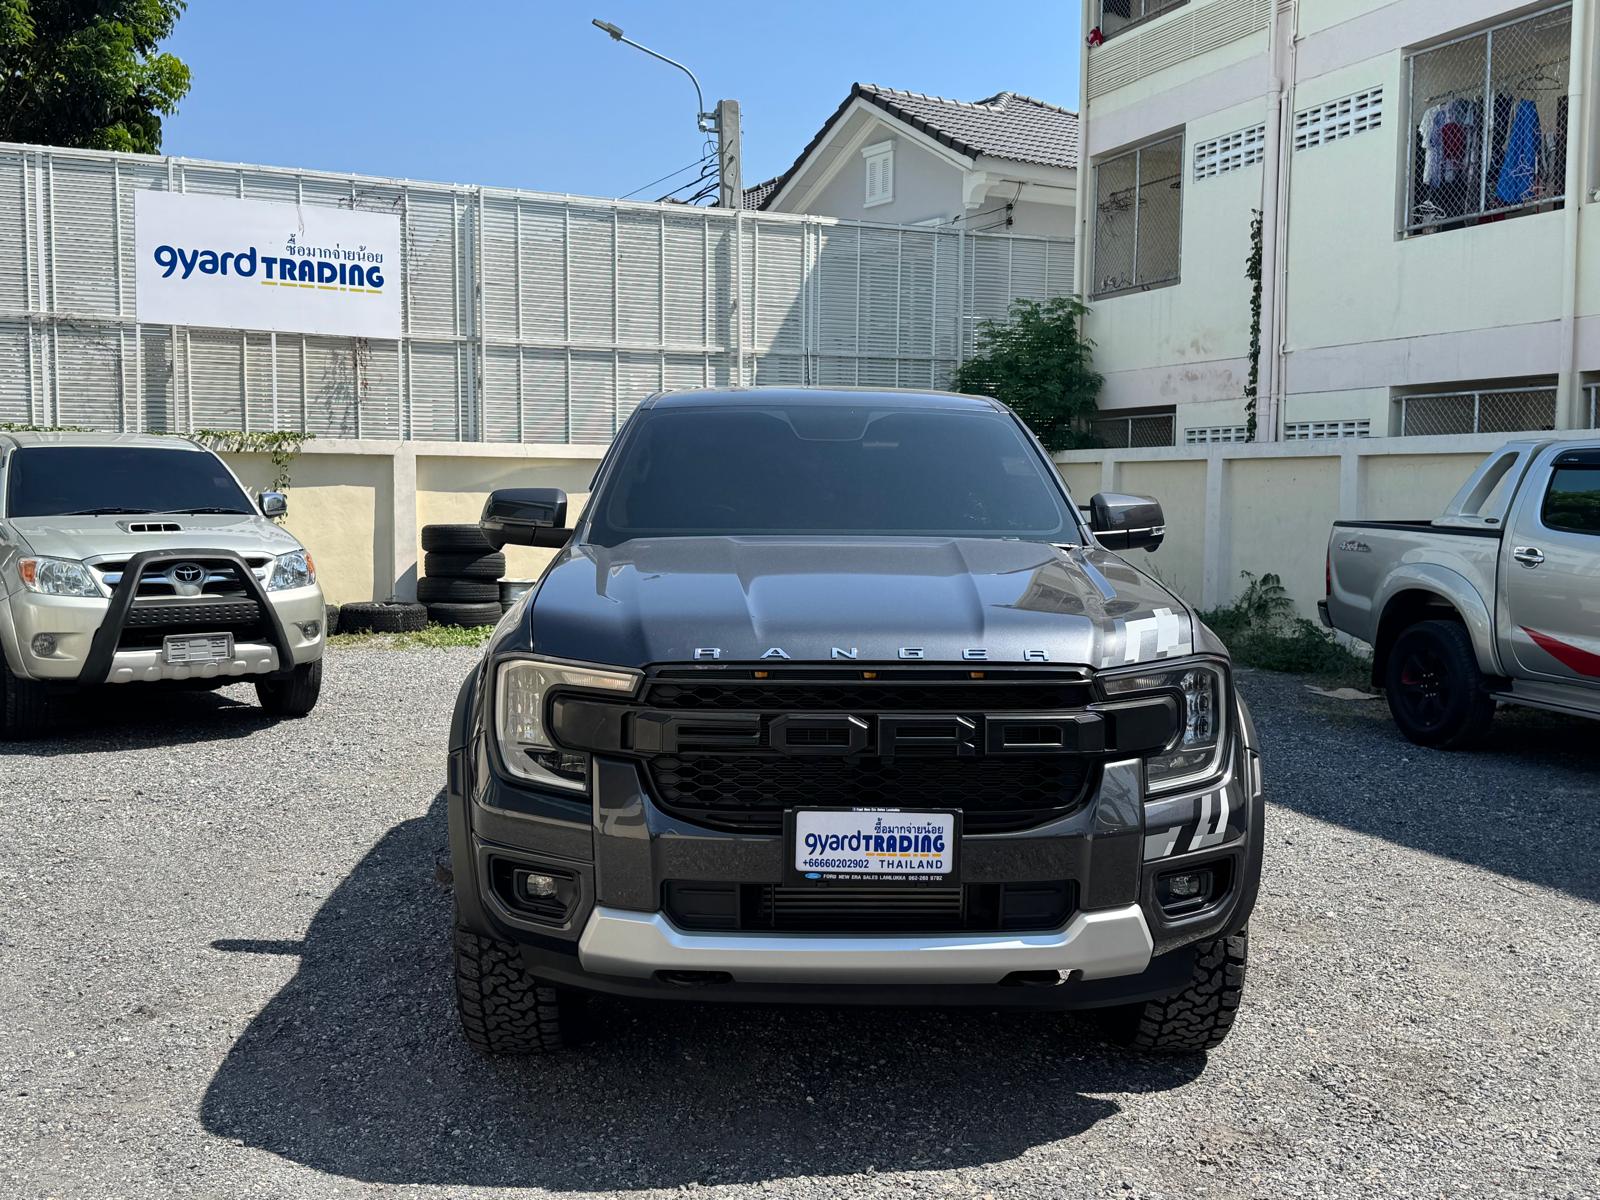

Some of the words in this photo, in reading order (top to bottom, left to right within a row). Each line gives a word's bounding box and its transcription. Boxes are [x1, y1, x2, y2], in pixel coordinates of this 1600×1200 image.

[286, 233, 384, 264] ซื้อมากจ่ายน้อย
[154, 245, 256, 279] 9yard
[261, 256, 384, 288] TRADING
[694, 648, 1050, 661] RANGER
[661, 713, 1086, 757] FORD
[874, 818, 944, 835] ซื้อมากจ่ายน้อย
[804, 830, 861, 855] 9yard
[862, 835, 945, 853] TRADING
[803, 858, 869, 869] +66660202902
[879, 860, 943, 869] THAILAND
